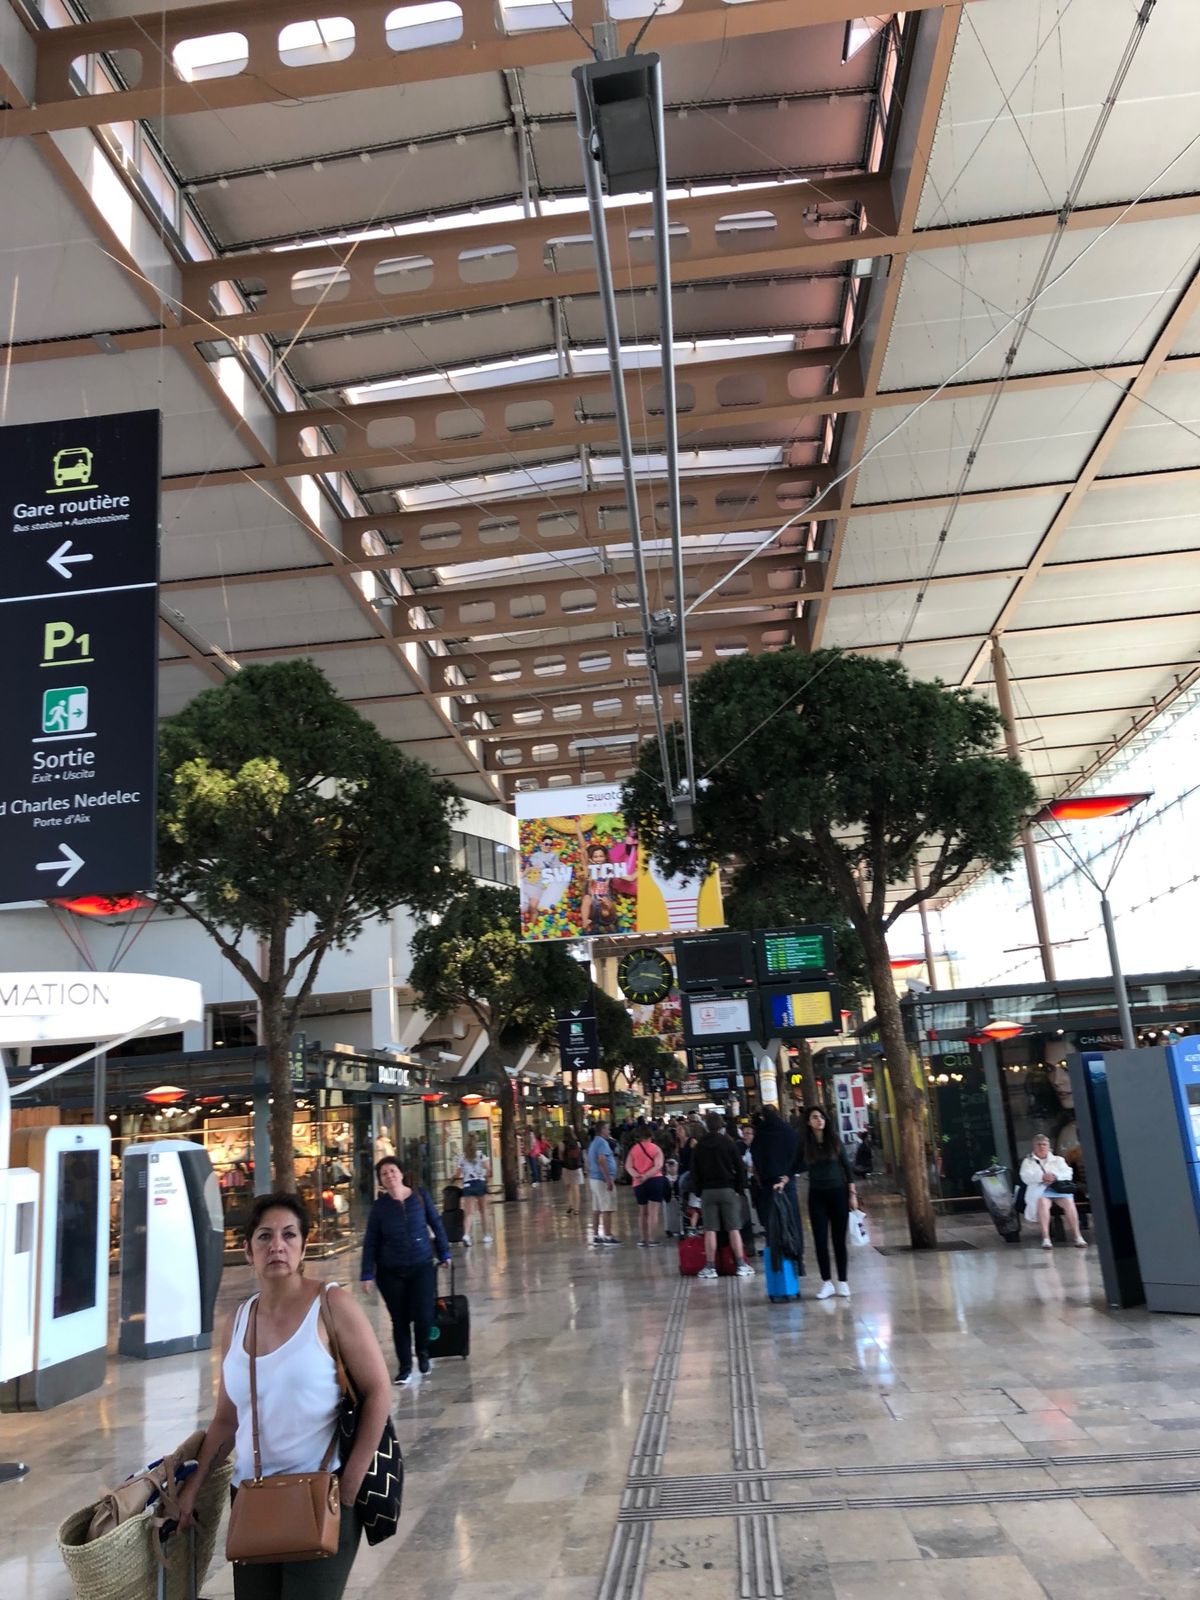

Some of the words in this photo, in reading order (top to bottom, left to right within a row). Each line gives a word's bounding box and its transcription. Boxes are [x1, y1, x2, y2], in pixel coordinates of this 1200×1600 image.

[13, 503, 55, 519] Gare
[59, 494, 130, 514] routière
[13, 523, 30, 533] Bus
[31, 520, 63, 531] station
[70, 512, 131, 527] Autostazione
[44, 621, 90, 660] P1
[32, 747, 96, 770] Sortie
[31, 773, 53, 784] Exit
[62, 769, 96, 781] Uscita
[10, 797, 70, 815] Charles
[74, 790, 141, 809] Nedelec
[33, 816, 63, 828] Porte
[64, 813, 91, 825] d'Aix
[0, 982, 110, 1006] MATION
[1079, 1034, 1125, 1045] CHANEL
